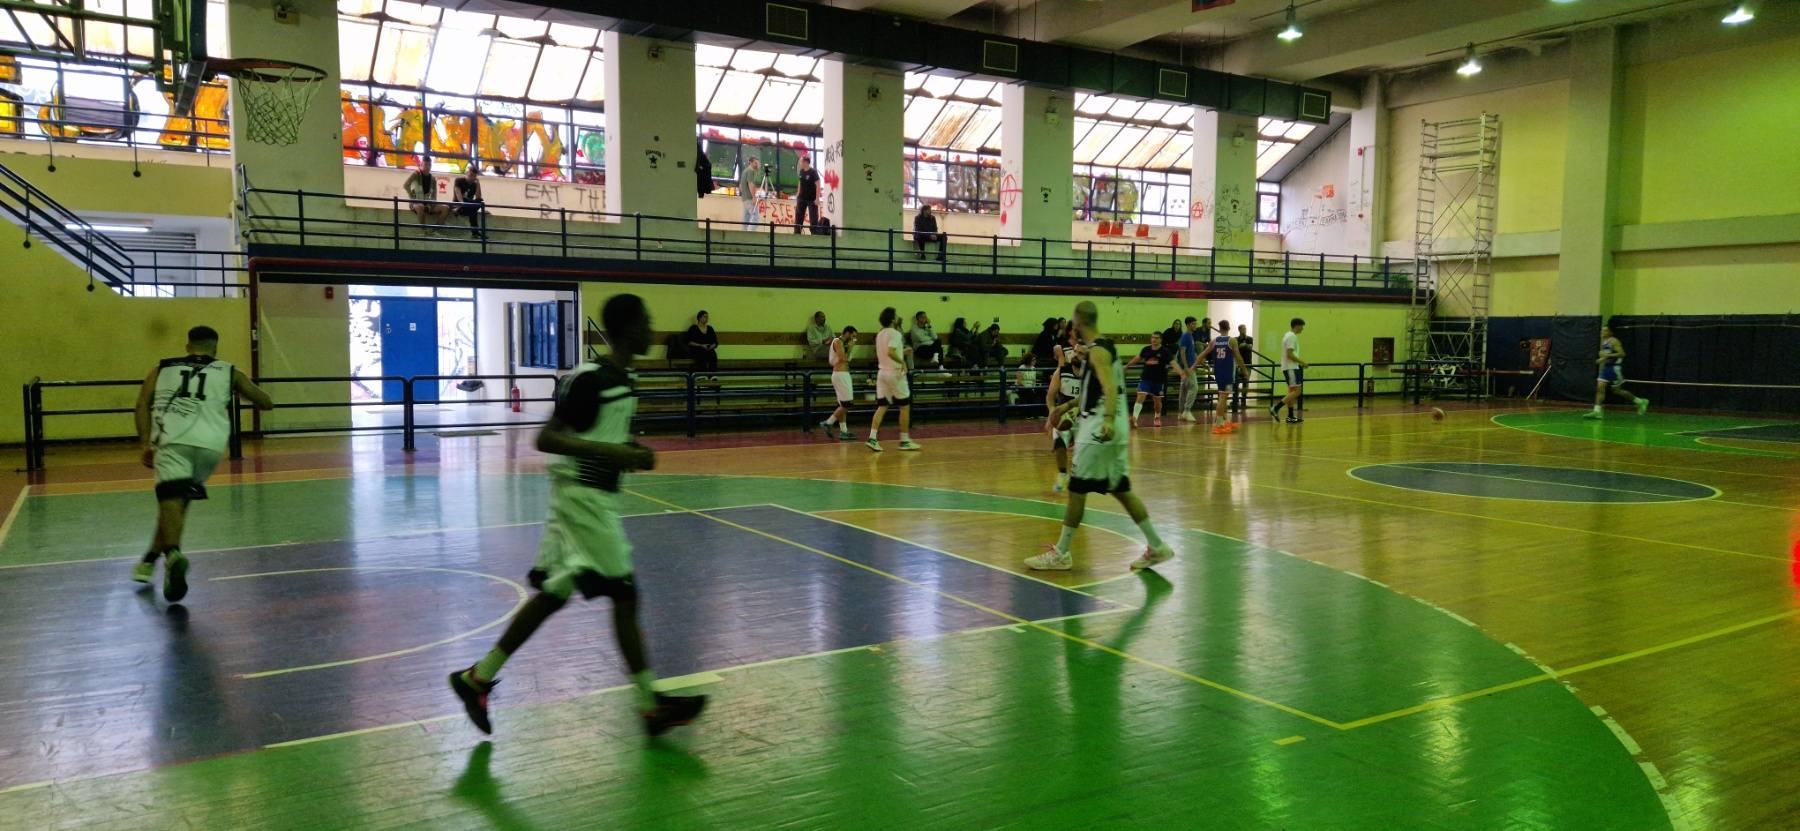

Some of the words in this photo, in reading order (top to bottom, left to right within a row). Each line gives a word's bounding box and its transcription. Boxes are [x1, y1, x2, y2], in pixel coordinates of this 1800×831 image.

[525, 183, 560, 204] EAT
[1216, 347, 1226, 359] 25
[176, 370, 207, 401] 11
[1071, 386, 1080, 395] 13
